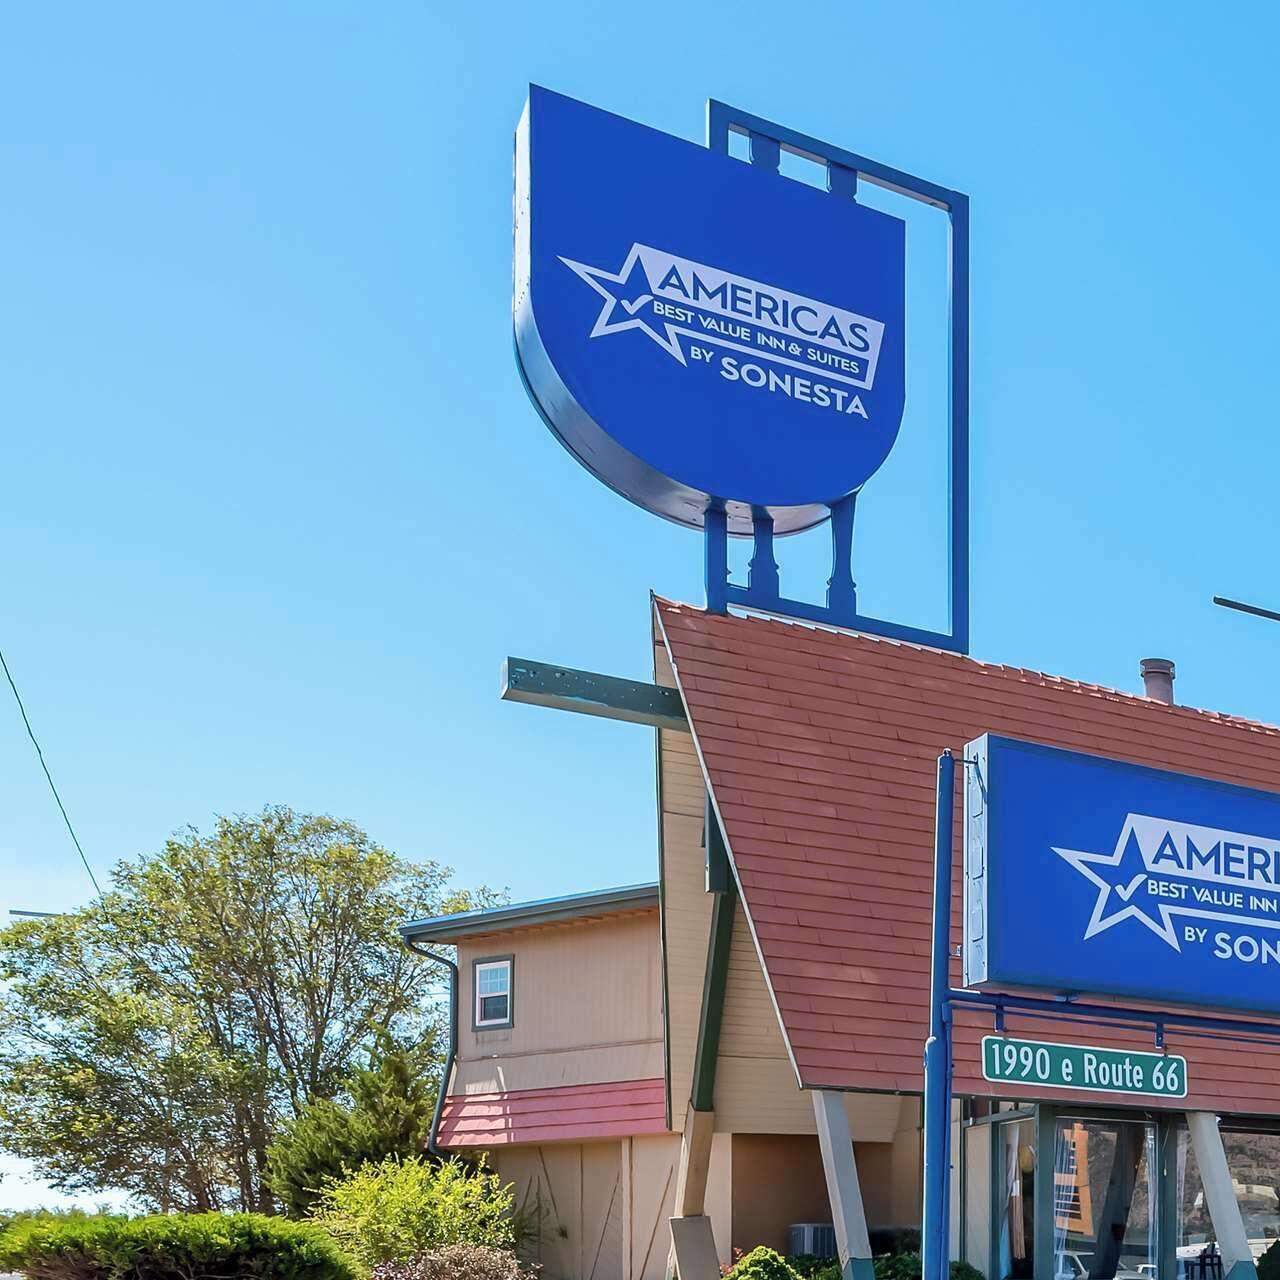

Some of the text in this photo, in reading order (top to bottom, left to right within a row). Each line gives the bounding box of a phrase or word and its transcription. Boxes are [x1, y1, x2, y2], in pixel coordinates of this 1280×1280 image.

[653, 300, 860, 374] BEST VALUE INN & SUITES
[658, 263, 870, 353] AMERICAS
[690, 346, 869, 420] BY SONESTA
[1147, 879, 1188, 900] BEST
[1192, 886, 1243, 908] VALUE
[1249, 895, 1277, 914] INN
[1184, 926, 1208, 943] BY
[991, 1043, 1180, 1091] 1990 e Route 66
